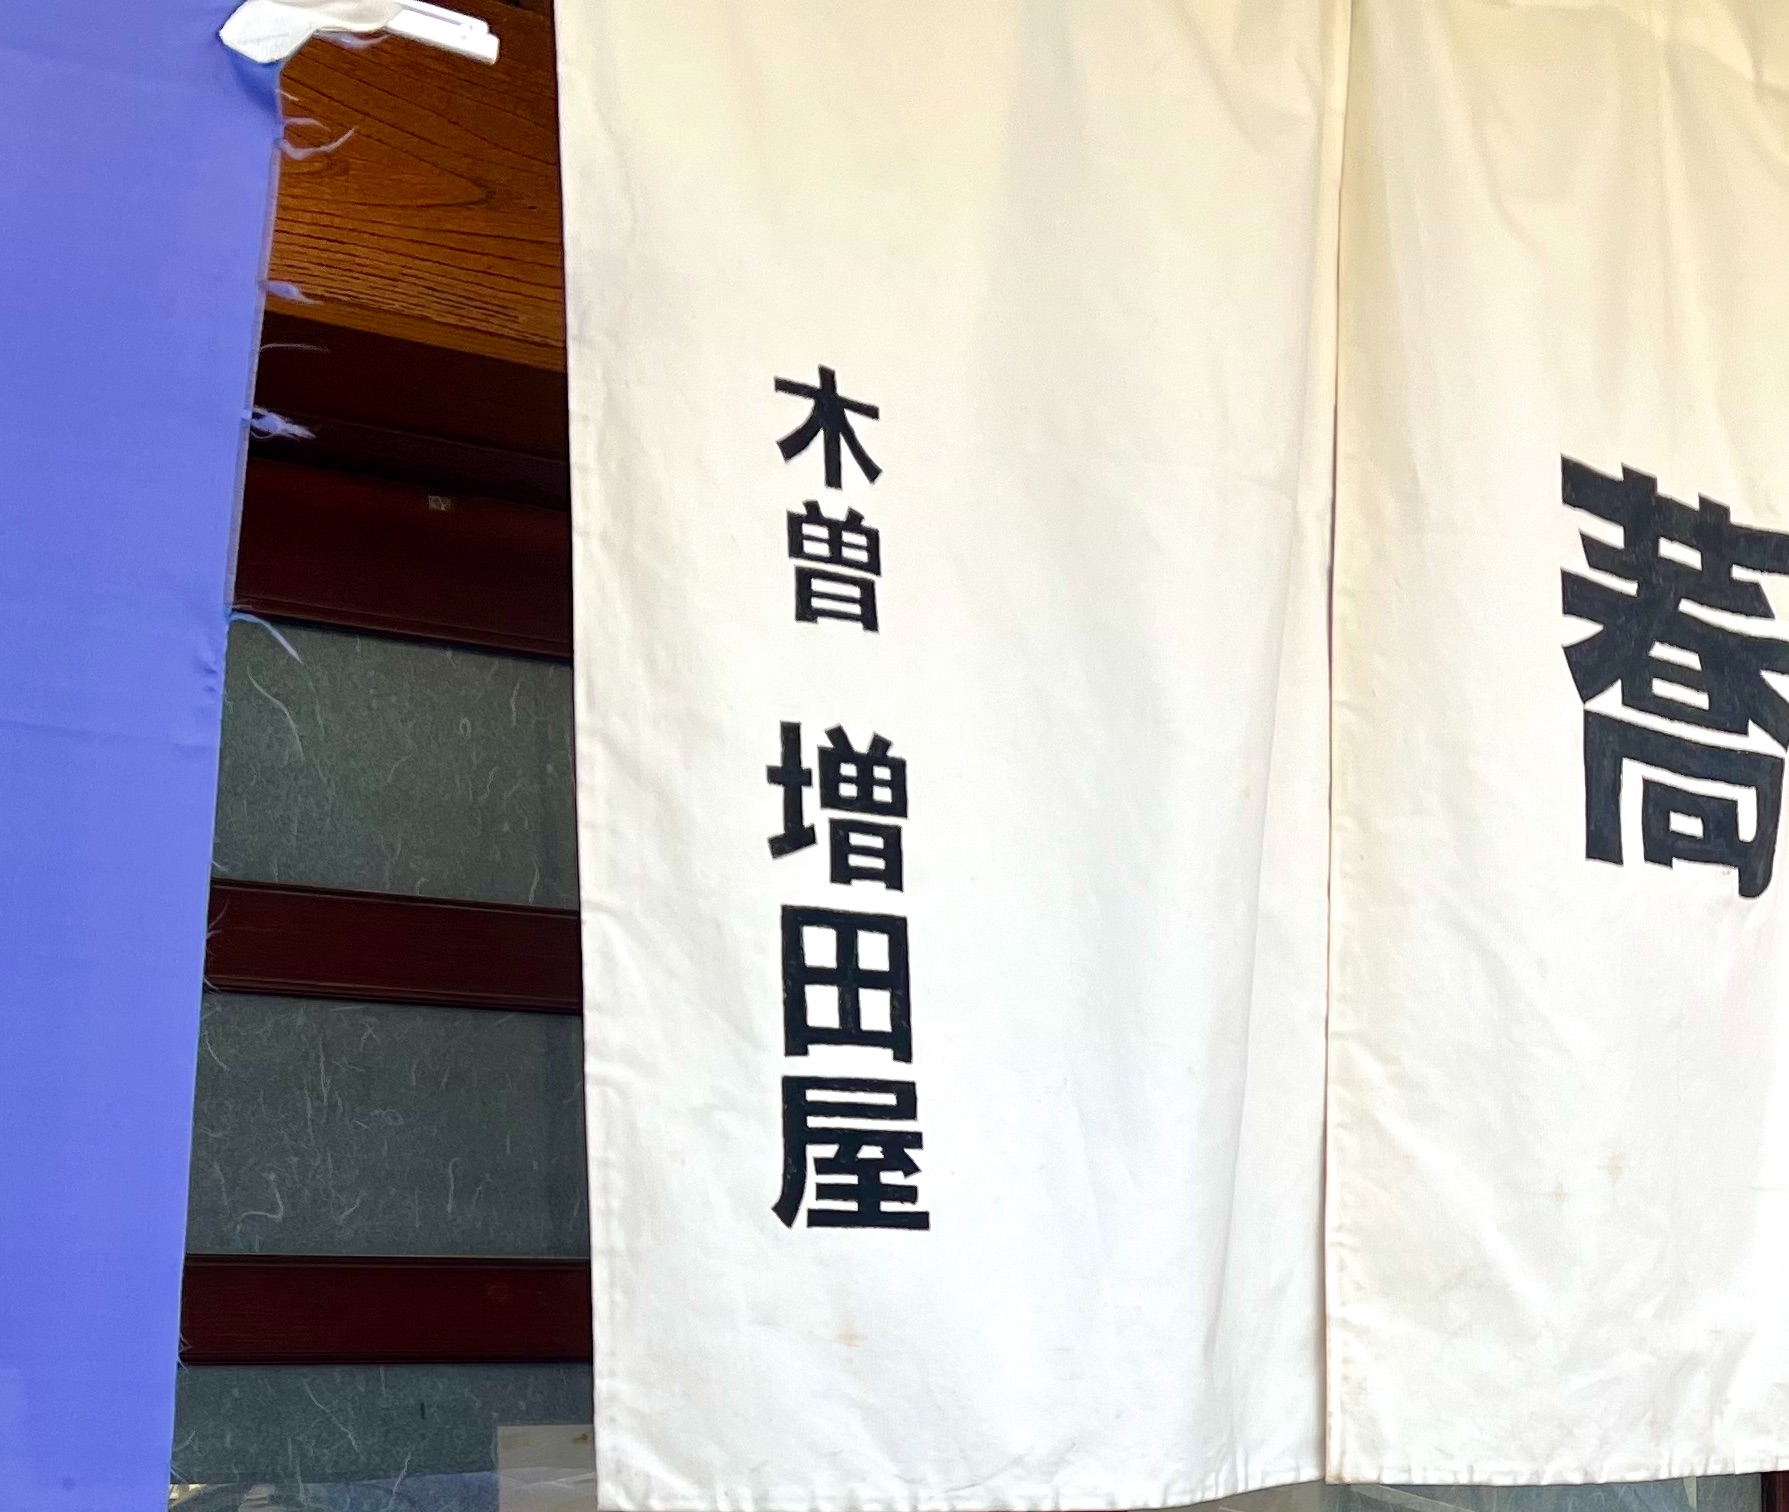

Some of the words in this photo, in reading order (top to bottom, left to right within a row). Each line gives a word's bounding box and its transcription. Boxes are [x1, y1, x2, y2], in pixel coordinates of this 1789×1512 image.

[773, 364, 883, 634] 木曽
[766, 721, 930, 1230] 増田屋
